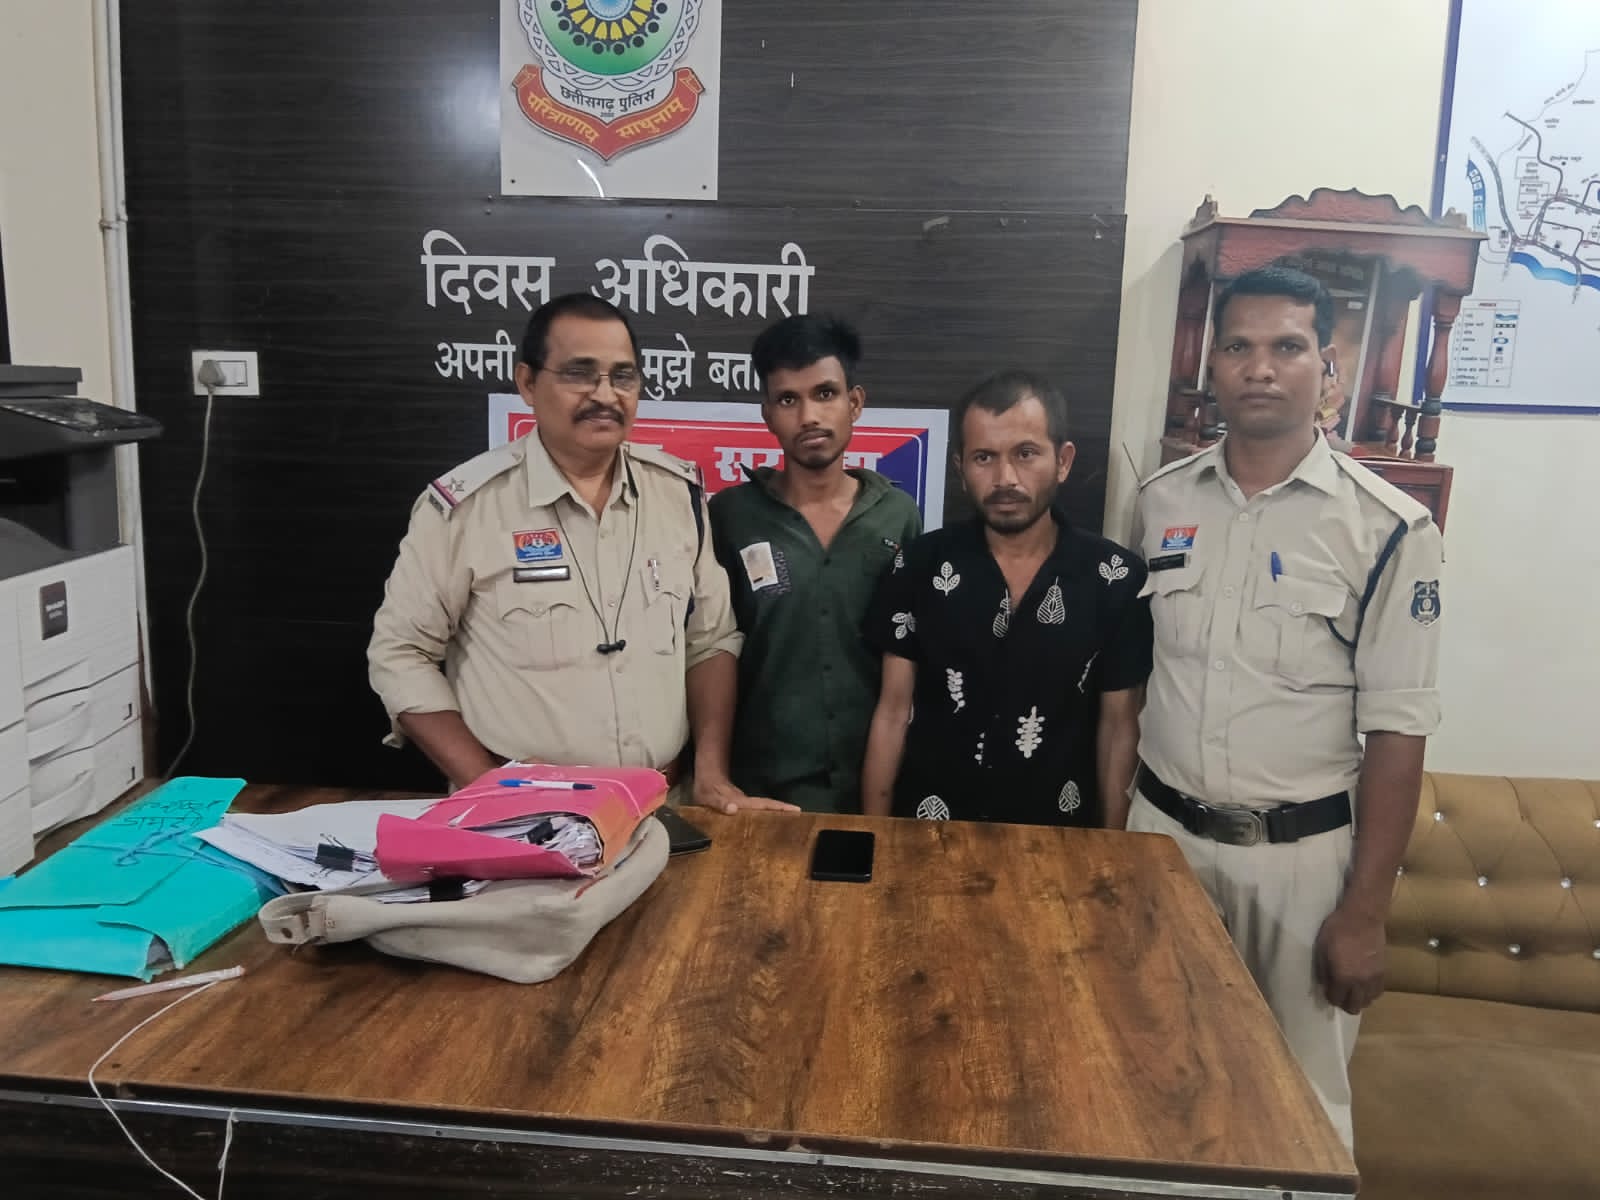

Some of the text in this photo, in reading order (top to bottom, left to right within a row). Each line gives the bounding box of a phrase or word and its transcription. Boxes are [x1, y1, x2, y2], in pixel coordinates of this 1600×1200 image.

[528, 91, 600, 143] परित्राणाय
[560, 85, 656, 112] छत्तीसगढ़ पुलिस
[421, 229, 815, 319] दिवस अधिकारी
[434, 329, 517, 382] अपनी
[640, 333, 696, 401] मुझे
